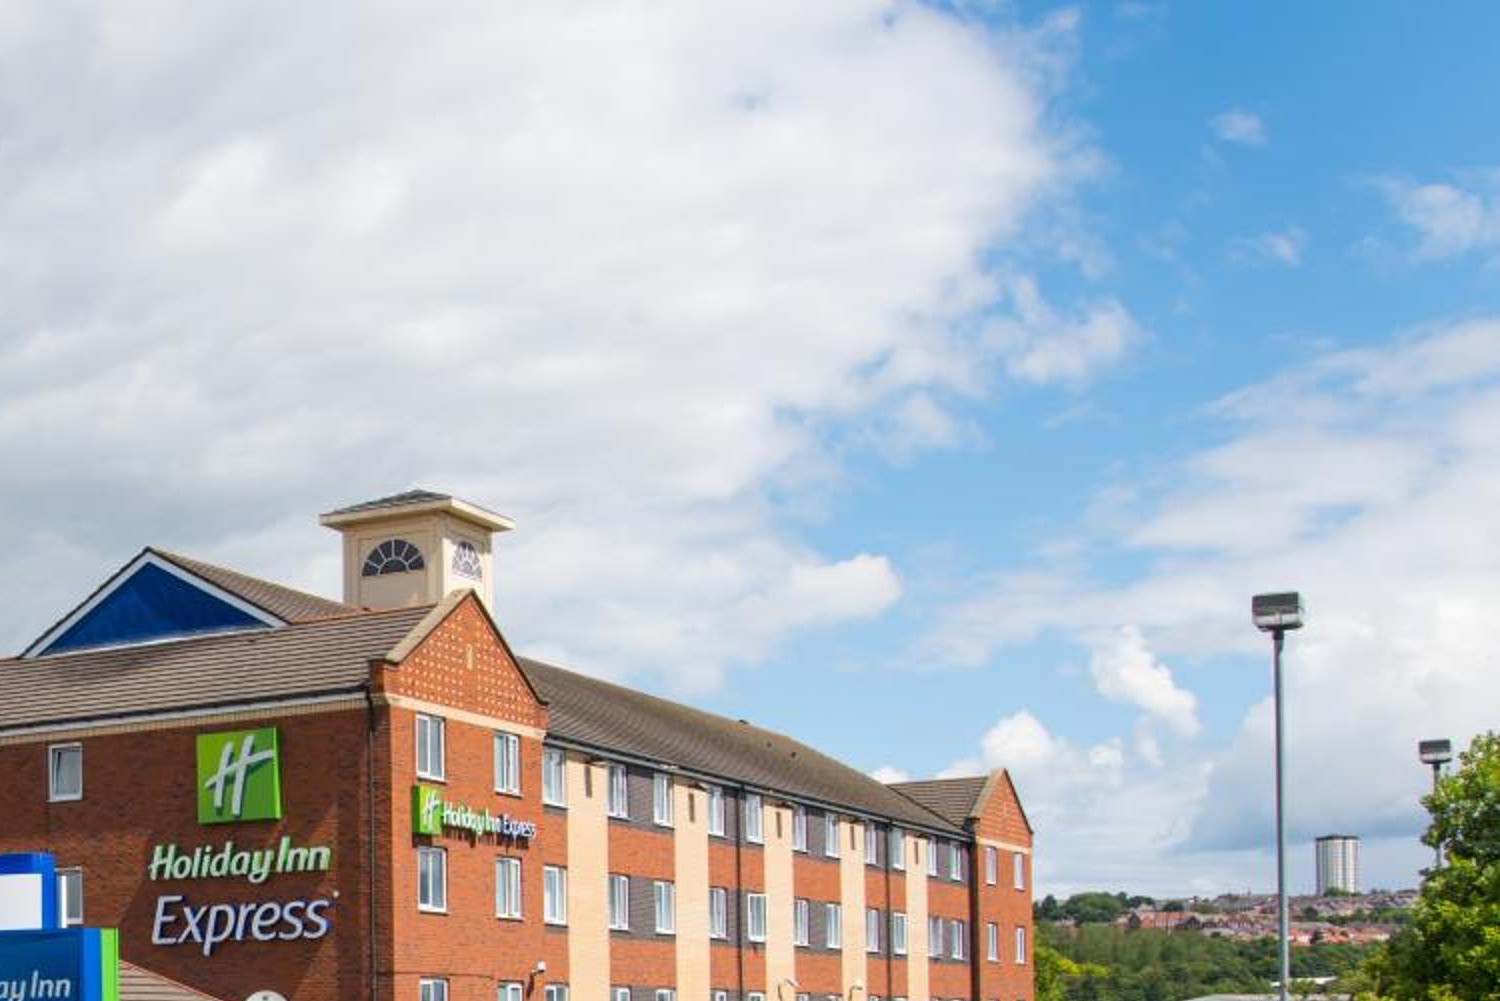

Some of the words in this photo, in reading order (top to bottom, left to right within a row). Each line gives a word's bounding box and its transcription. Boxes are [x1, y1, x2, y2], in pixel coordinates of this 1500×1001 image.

[443, 800, 483, 836] Holiday
[148, 840, 275, 883] Holiday
[276, 836, 331, 873] Inn
[151, 895, 331, 957] Express
[30, 970, 71, 998] Inn
